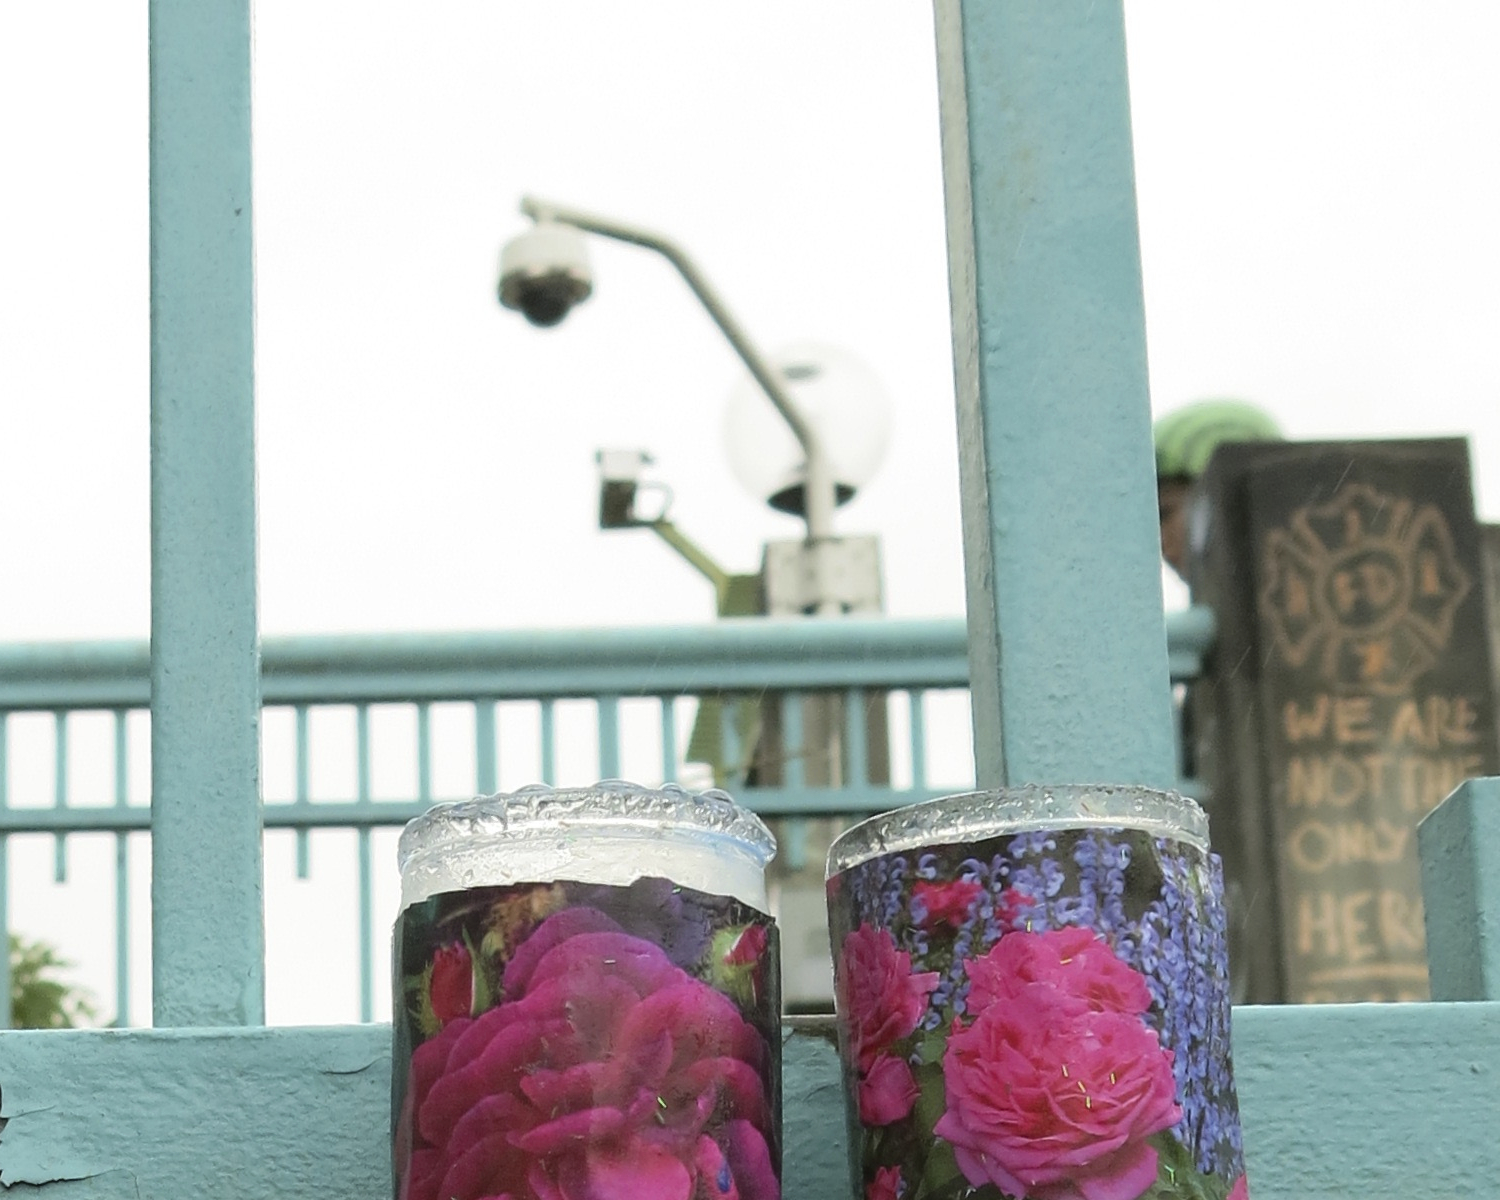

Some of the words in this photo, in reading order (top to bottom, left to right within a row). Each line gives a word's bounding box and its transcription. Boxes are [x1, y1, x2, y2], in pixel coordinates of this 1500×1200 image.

[1284, 695, 1376, 743] WE
[1390, 695, 1479, 749] ARE
[1287, 753, 1388, 808] NOT
[1299, 888, 1426, 960] HER
